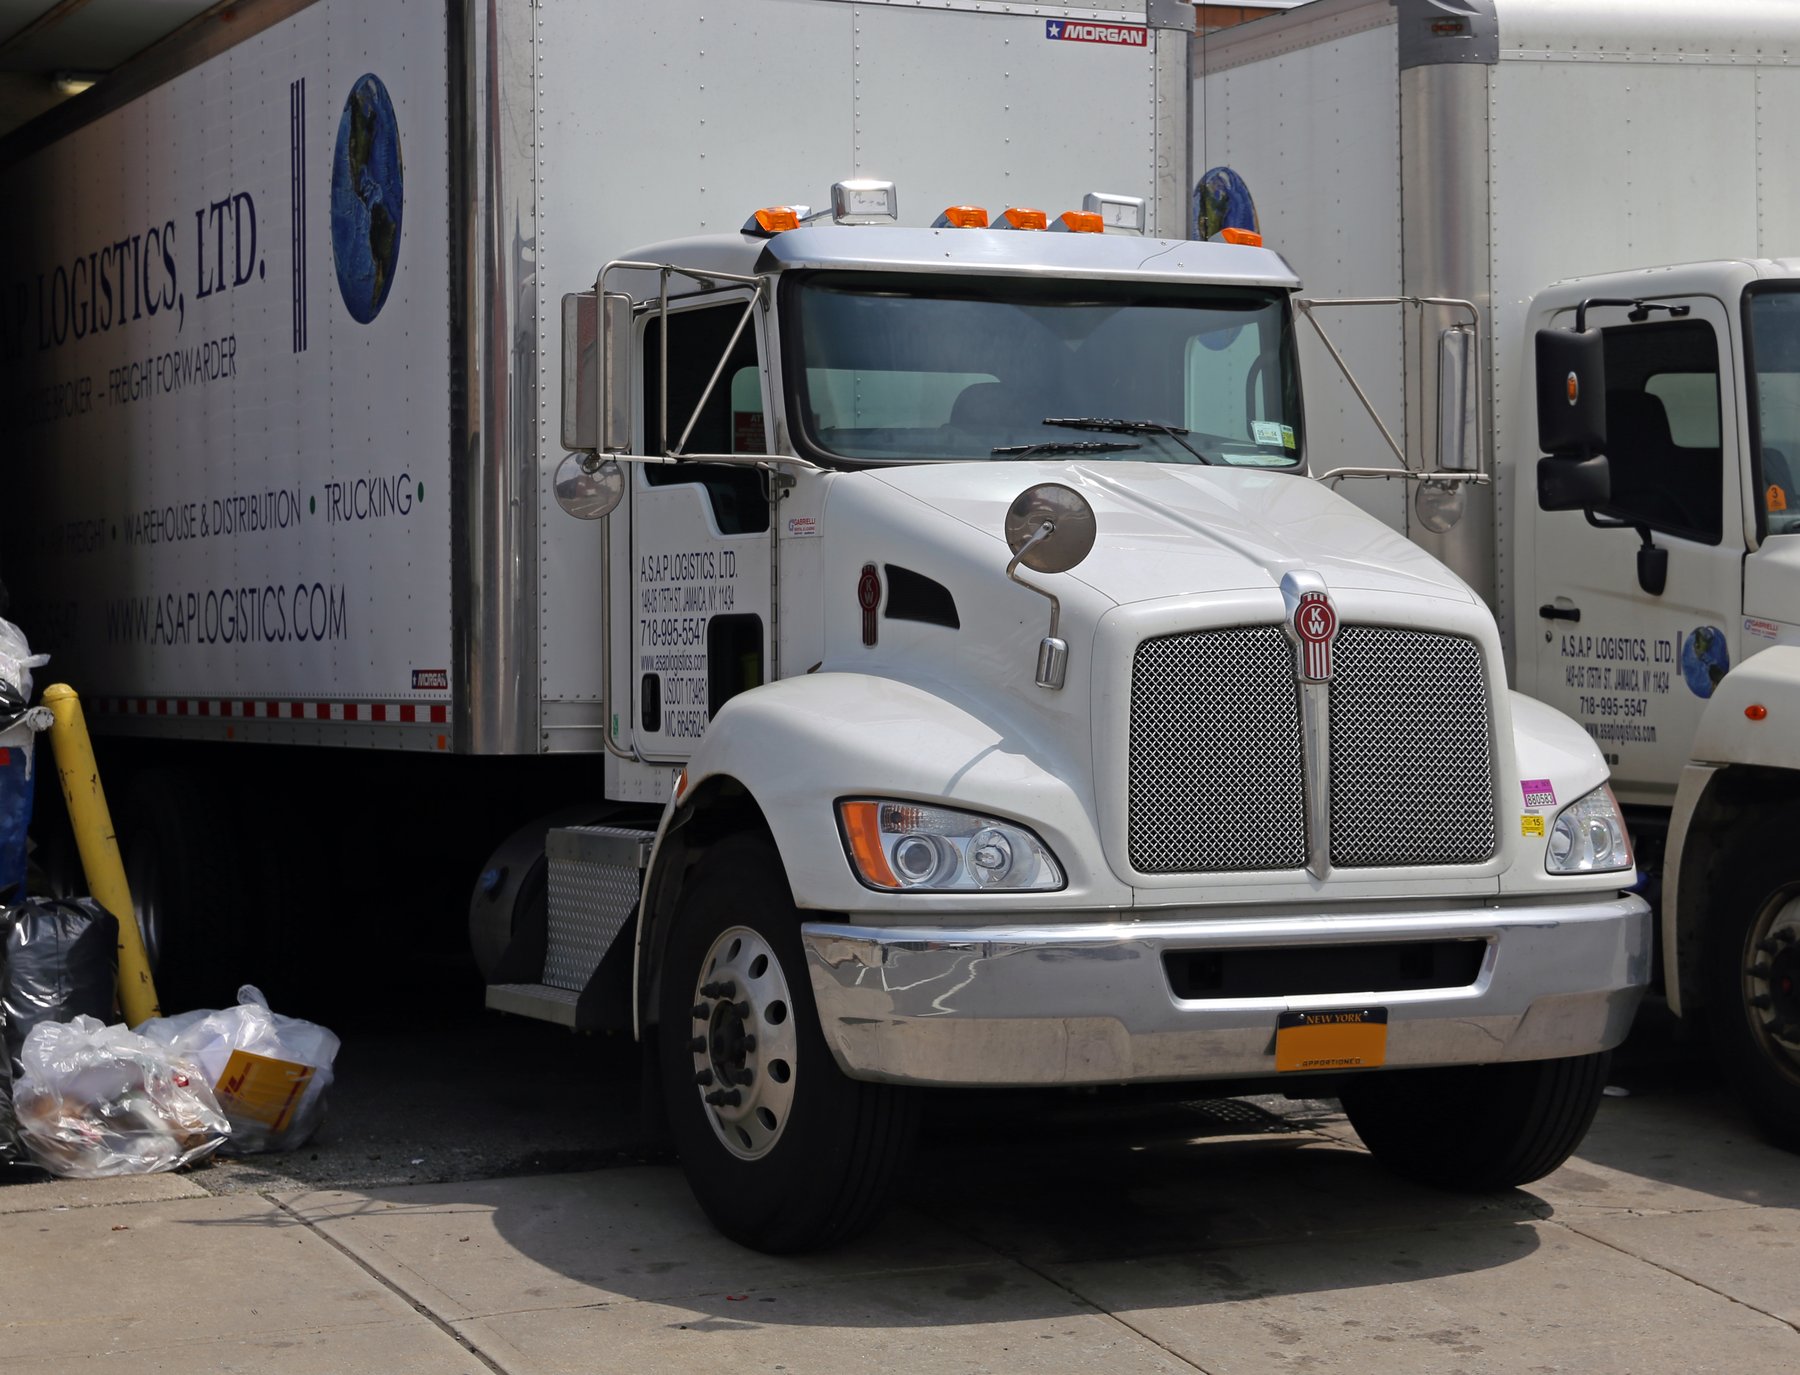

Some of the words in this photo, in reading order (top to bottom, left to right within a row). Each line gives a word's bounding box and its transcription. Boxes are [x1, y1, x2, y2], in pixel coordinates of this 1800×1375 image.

[1064, 24, 1143, 45] MORGAN
[38, 219, 187, 352] LOGISTICS,
[196, 190, 266, 300] LTD.
[109, 358, 155, 406] FREIGHT
[156, 335, 238, 394] FORWARDER
[1771, 486, 1778, 498] 3
[124, 503, 197, 547] WAREHOUSE
[200, 508, 209, 537] &
[213, 488, 301, 537] DISTRIBUTION
[324, 473, 413, 523] TRUCKING
[670, 550, 717, 584] LOGISTICS,
[719, 550, 738, 579] LTD.
[106, 582, 348, 646] WWW.ASAPLOGISTICS.COM
[640, 618, 707, 647] 718-995-5547
[1595, 636, 1650, 666] LOGISTICS,
[1654, 638, 1674, 664] LTD.
[417, 672, 447, 687] MORGAN
[664, 677, 684, 705] USDOT
[1579, 695, 1648, 718] 718-995-5547
[664, 710, 677, 738] MC
[1306, 1014, 1332, 1024] NEW
[1335, 1012, 1363, 1023] YORK
